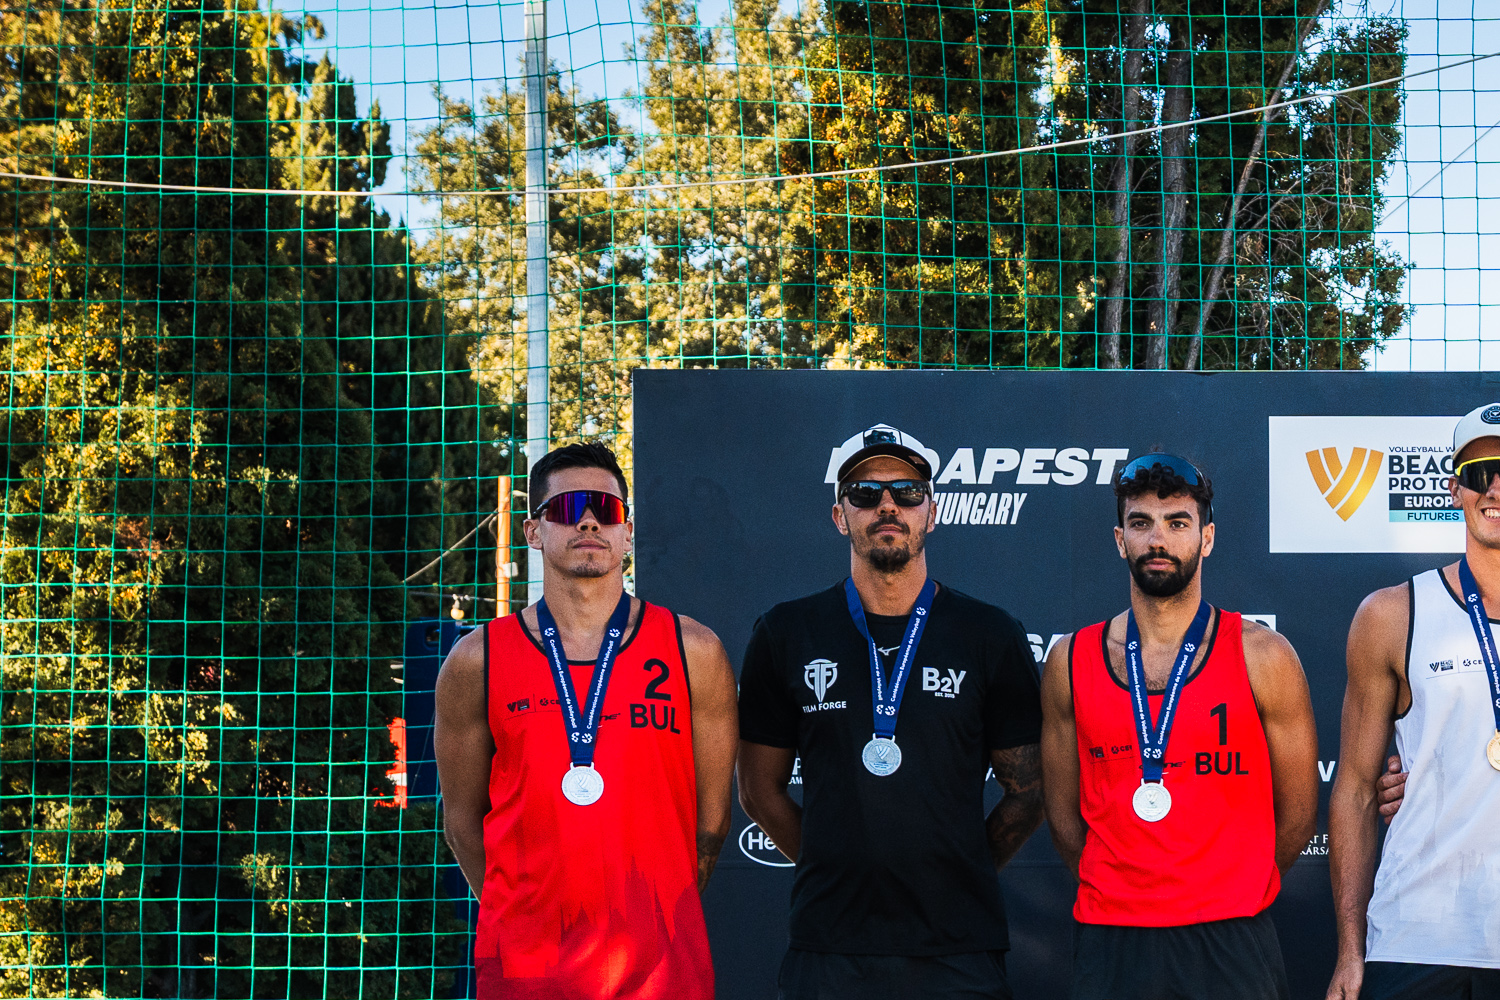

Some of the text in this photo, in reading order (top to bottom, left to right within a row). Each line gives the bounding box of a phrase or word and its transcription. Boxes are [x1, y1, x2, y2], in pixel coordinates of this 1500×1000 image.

[824, 447, 1129, 485] APEST
[1388, 454, 1454, 475] BEAC
[1388, 477, 1449, 491] PRO TO
[933, 492, 1027, 525] HUNGARY
[1404, 495, 1453, 508] EUROP
[1407, 512, 1460, 521] FUTURES
[643, 658, 672, 701] 2
[922, 667, 966, 694] B2Y
[818, 701, 847, 711] FORGE
[630, 704, 681, 735] BUL
[1210, 703, 1227, 746] 1
[1195, 752, 1249, 775] BUL
